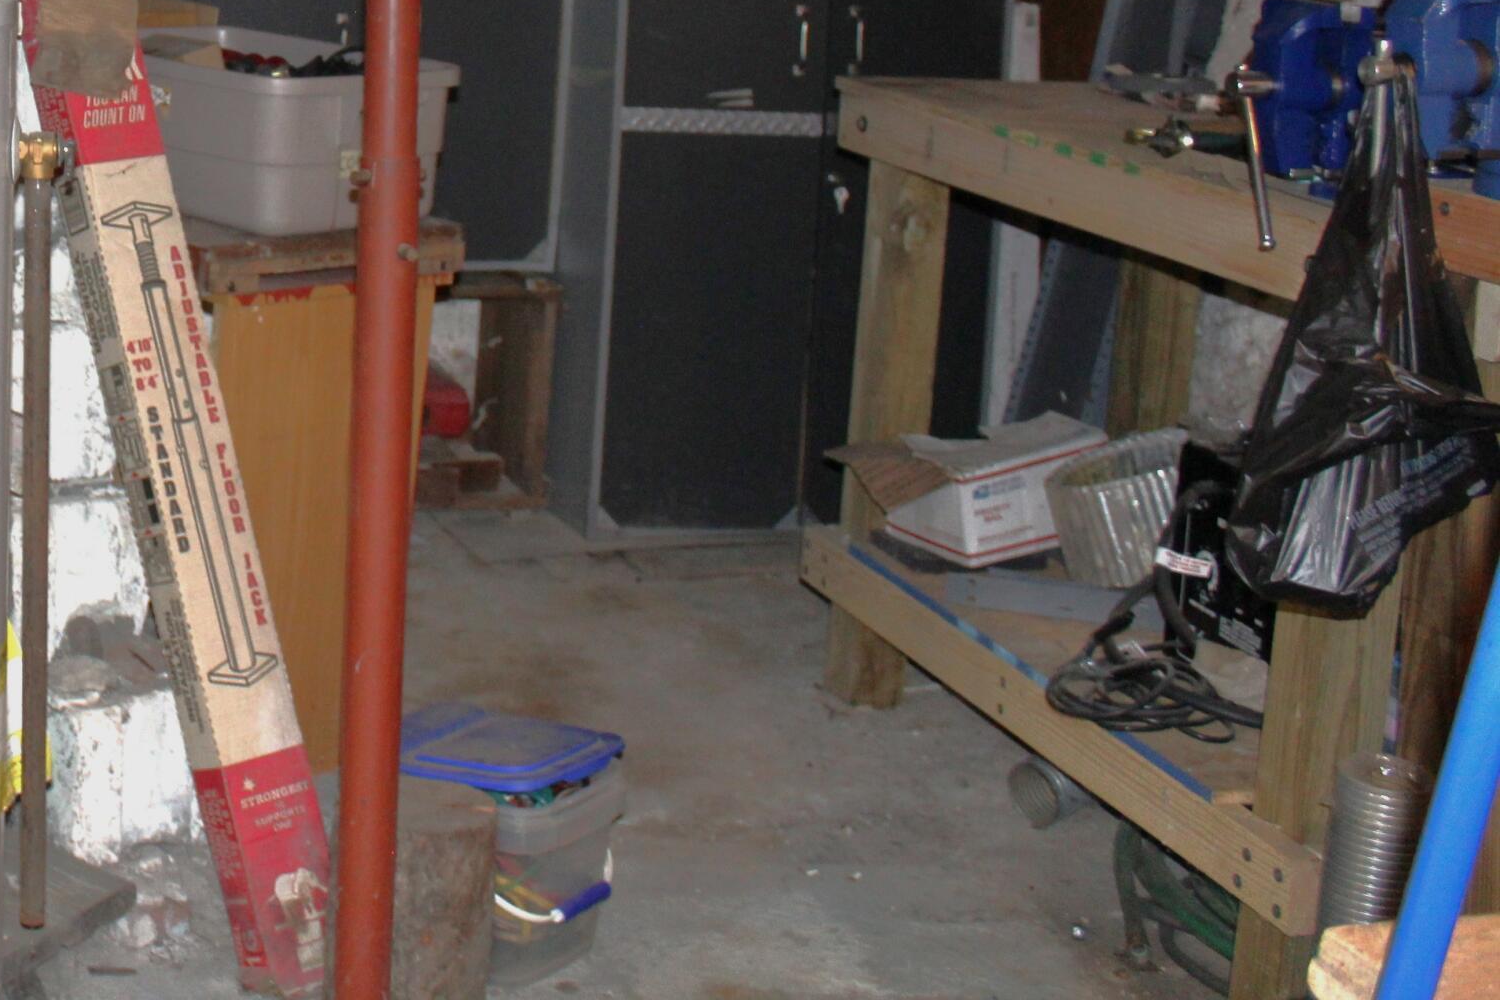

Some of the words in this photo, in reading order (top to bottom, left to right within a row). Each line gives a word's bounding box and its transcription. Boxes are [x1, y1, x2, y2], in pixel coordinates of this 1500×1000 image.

[113, 86, 139, 104] AN
[83, 107, 124, 129] COUNT
[128, 104, 146, 123] ON
[132, 358, 153, 371] TO
[170, 245, 220, 423] ADJUSTABLE
[216, 443, 246, 534] FLOOR
[244, 552, 267, 626] JACK
[146, 406, 190, 553] STANDARD
[240, 780, 309, 809] STRONGEST
